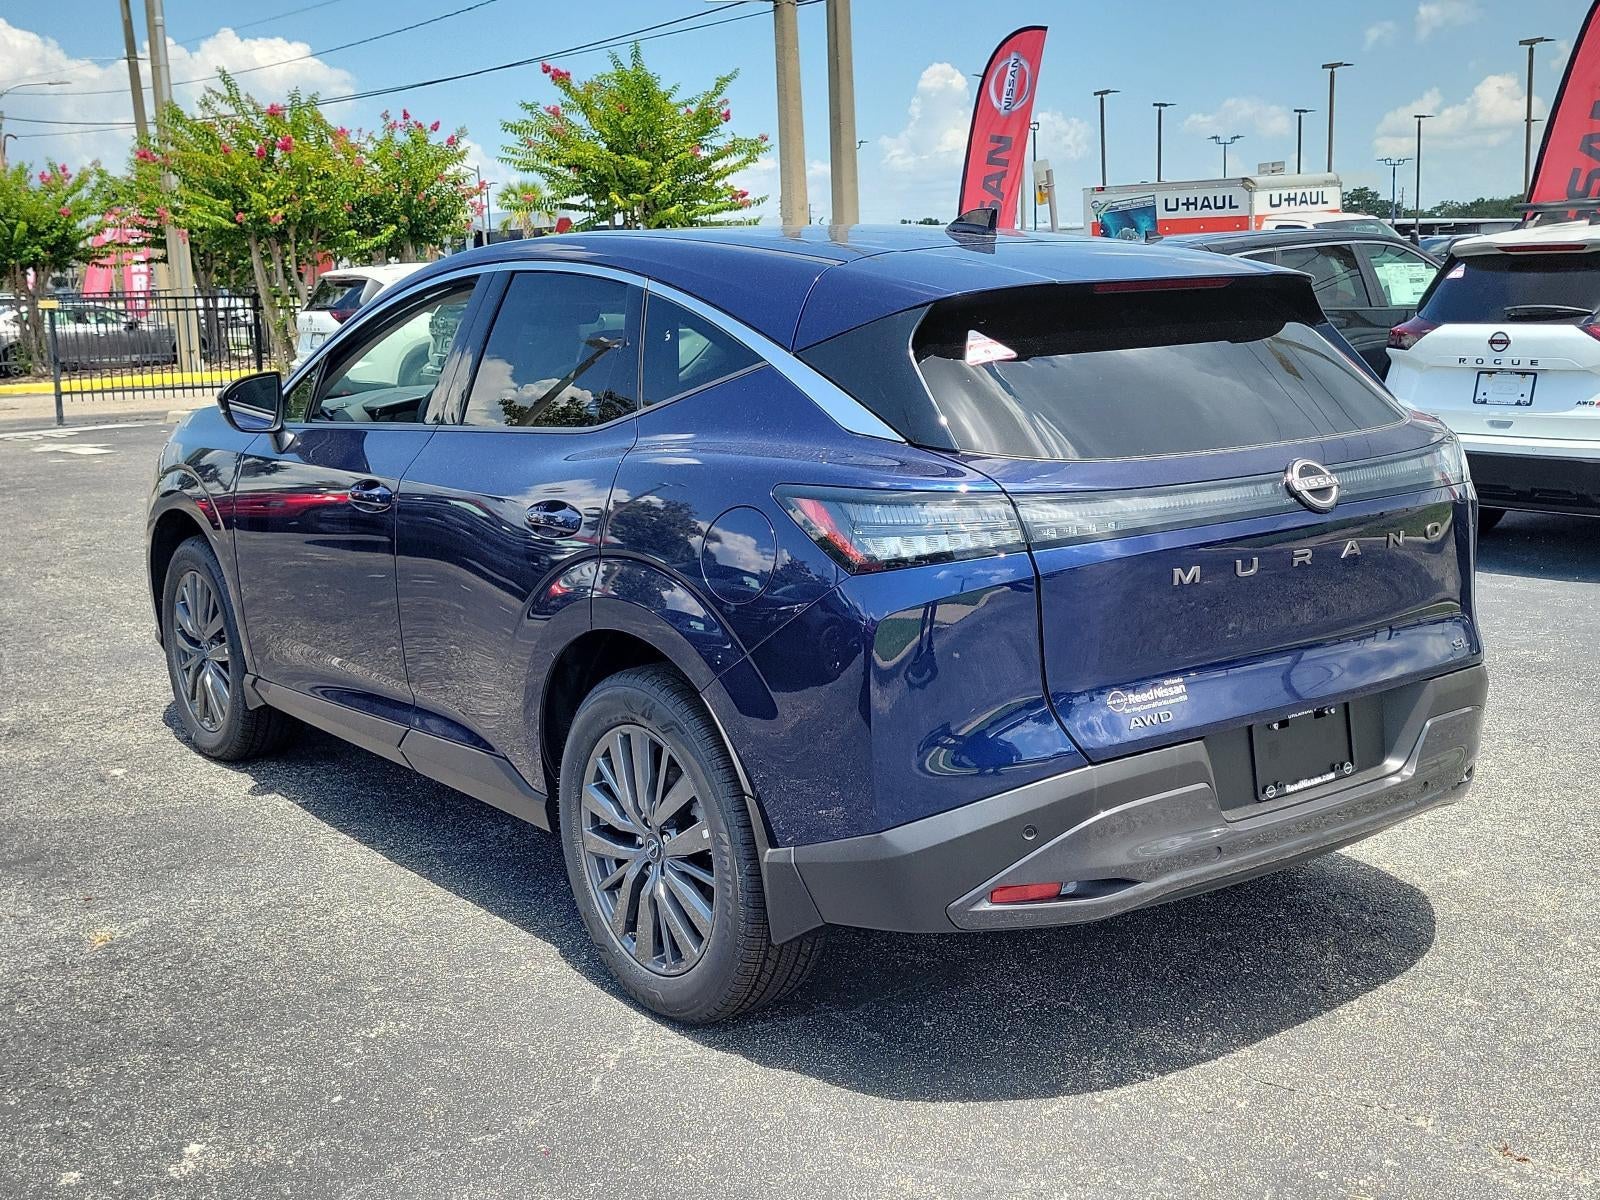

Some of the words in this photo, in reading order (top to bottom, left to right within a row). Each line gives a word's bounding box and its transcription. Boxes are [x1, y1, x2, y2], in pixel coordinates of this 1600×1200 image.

[1004, 58, 1020, 111] NISSAN
[1164, 194, 1239, 212] U-HAUL
[1269, 190, 1329, 207] U-HAUL
[1458, 357, 1539, 367] ROGUE
[1296, 475, 1340, 489] NISSAN
[1172, 521, 1443, 586] MURANO
[1128, 711, 1173, 730] AWD
